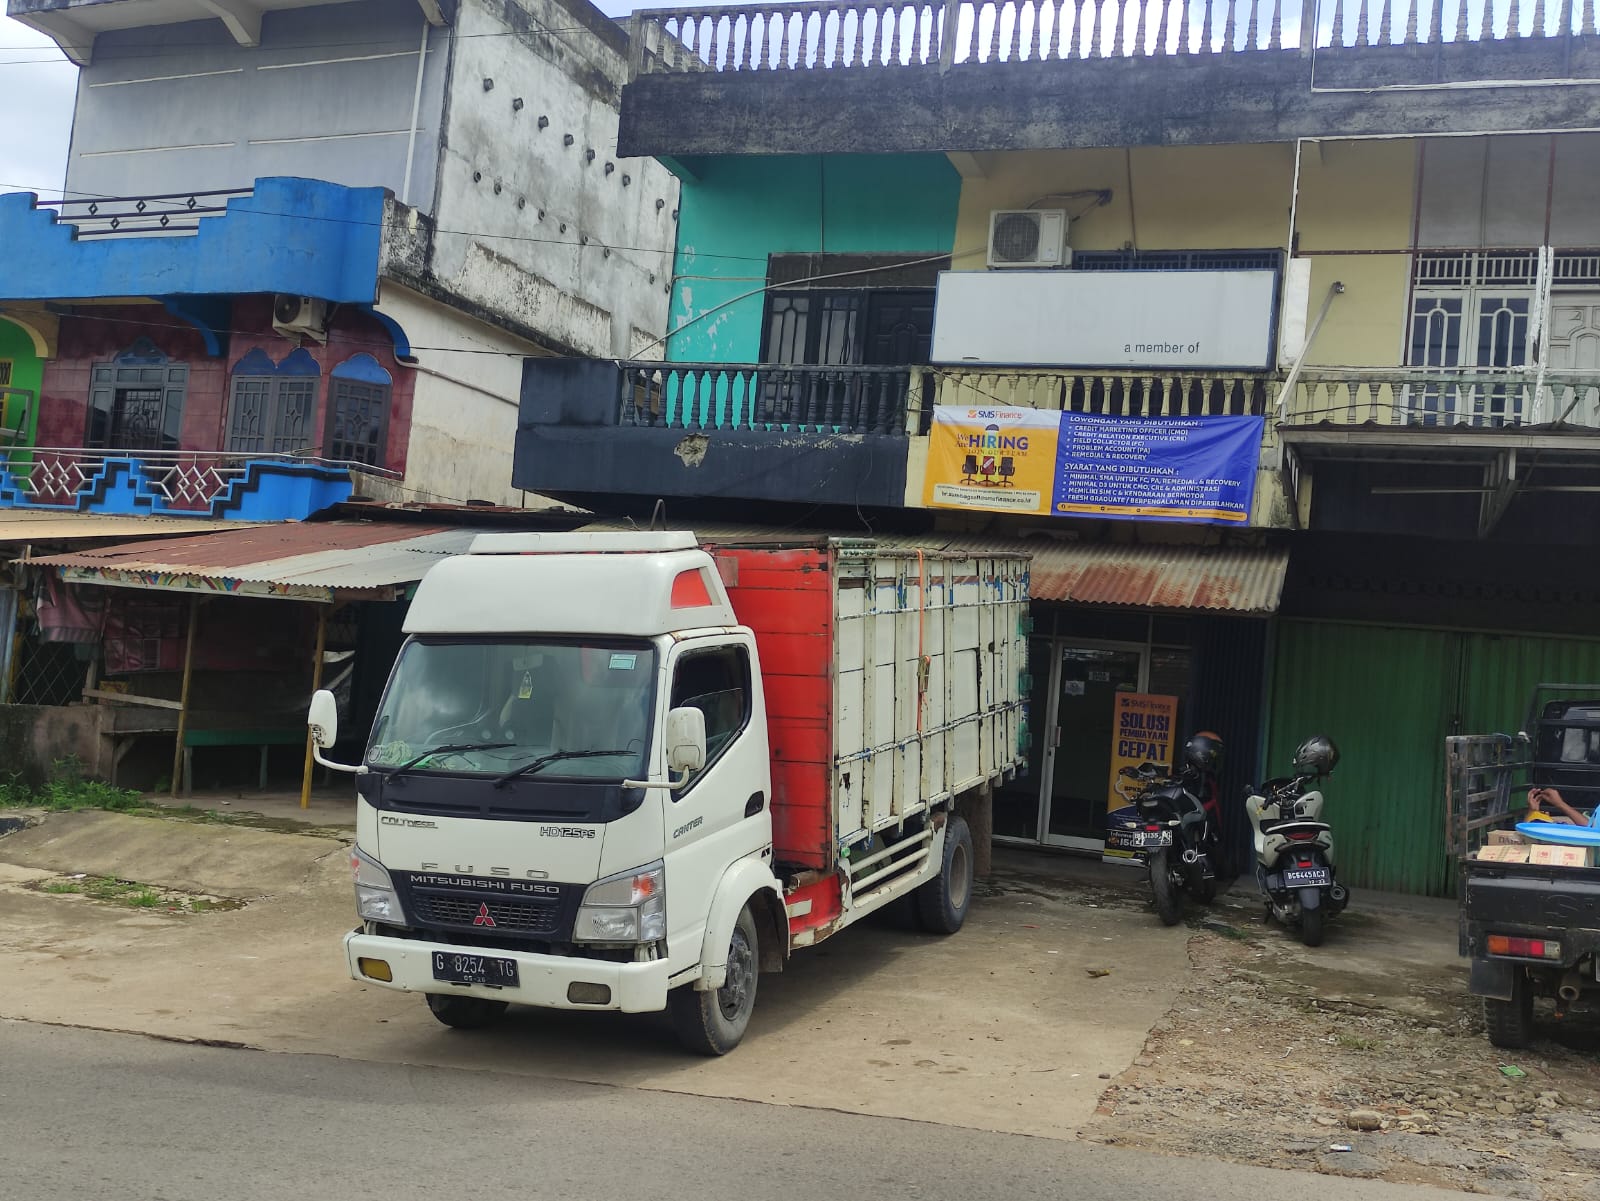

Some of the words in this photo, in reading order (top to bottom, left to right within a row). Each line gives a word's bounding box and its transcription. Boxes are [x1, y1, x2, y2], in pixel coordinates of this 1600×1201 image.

[1124, 344, 1131, 353] a
[1135, 341, 1184, 353] member
[1187, 341, 1200, 353] of
[1070, 416, 1117, 424] LOWONGAN
[969, 434, 1029, 451] HIRING
[1064, 463, 1094, 471] SYARAT
[1095, 464, 1118, 472] YANG
[1120, 465, 1174, 475] DIBUTUHKAN
[1205, 479, 1241, 487] RECOVERY
[1068, 487, 1099, 495] MEMILIKI
[1124, 490, 1166, 498] KENDARAAN
[1130, 497, 1190, 506] BERPENGALAMAN
[1190, 500, 1244, 509] DIPERSILAHKAN
[1120, 712, 1170, 732] SOLUSI
[1119, 728, 1168, 741] PEMBIAYAAN
[1118, 740, 1168, 761] CEPAT
[672, 815, 703, 839] CANTER
[421, 862, 549, 879] FUSO
[410, 874, 505, 890] MITSUBISHI
[510, 882, 560, 894] FUSO
[436, 953, 444, 970] G
[454, 955, 485, 975] 8254
[497, 959, 514, 977] TG
